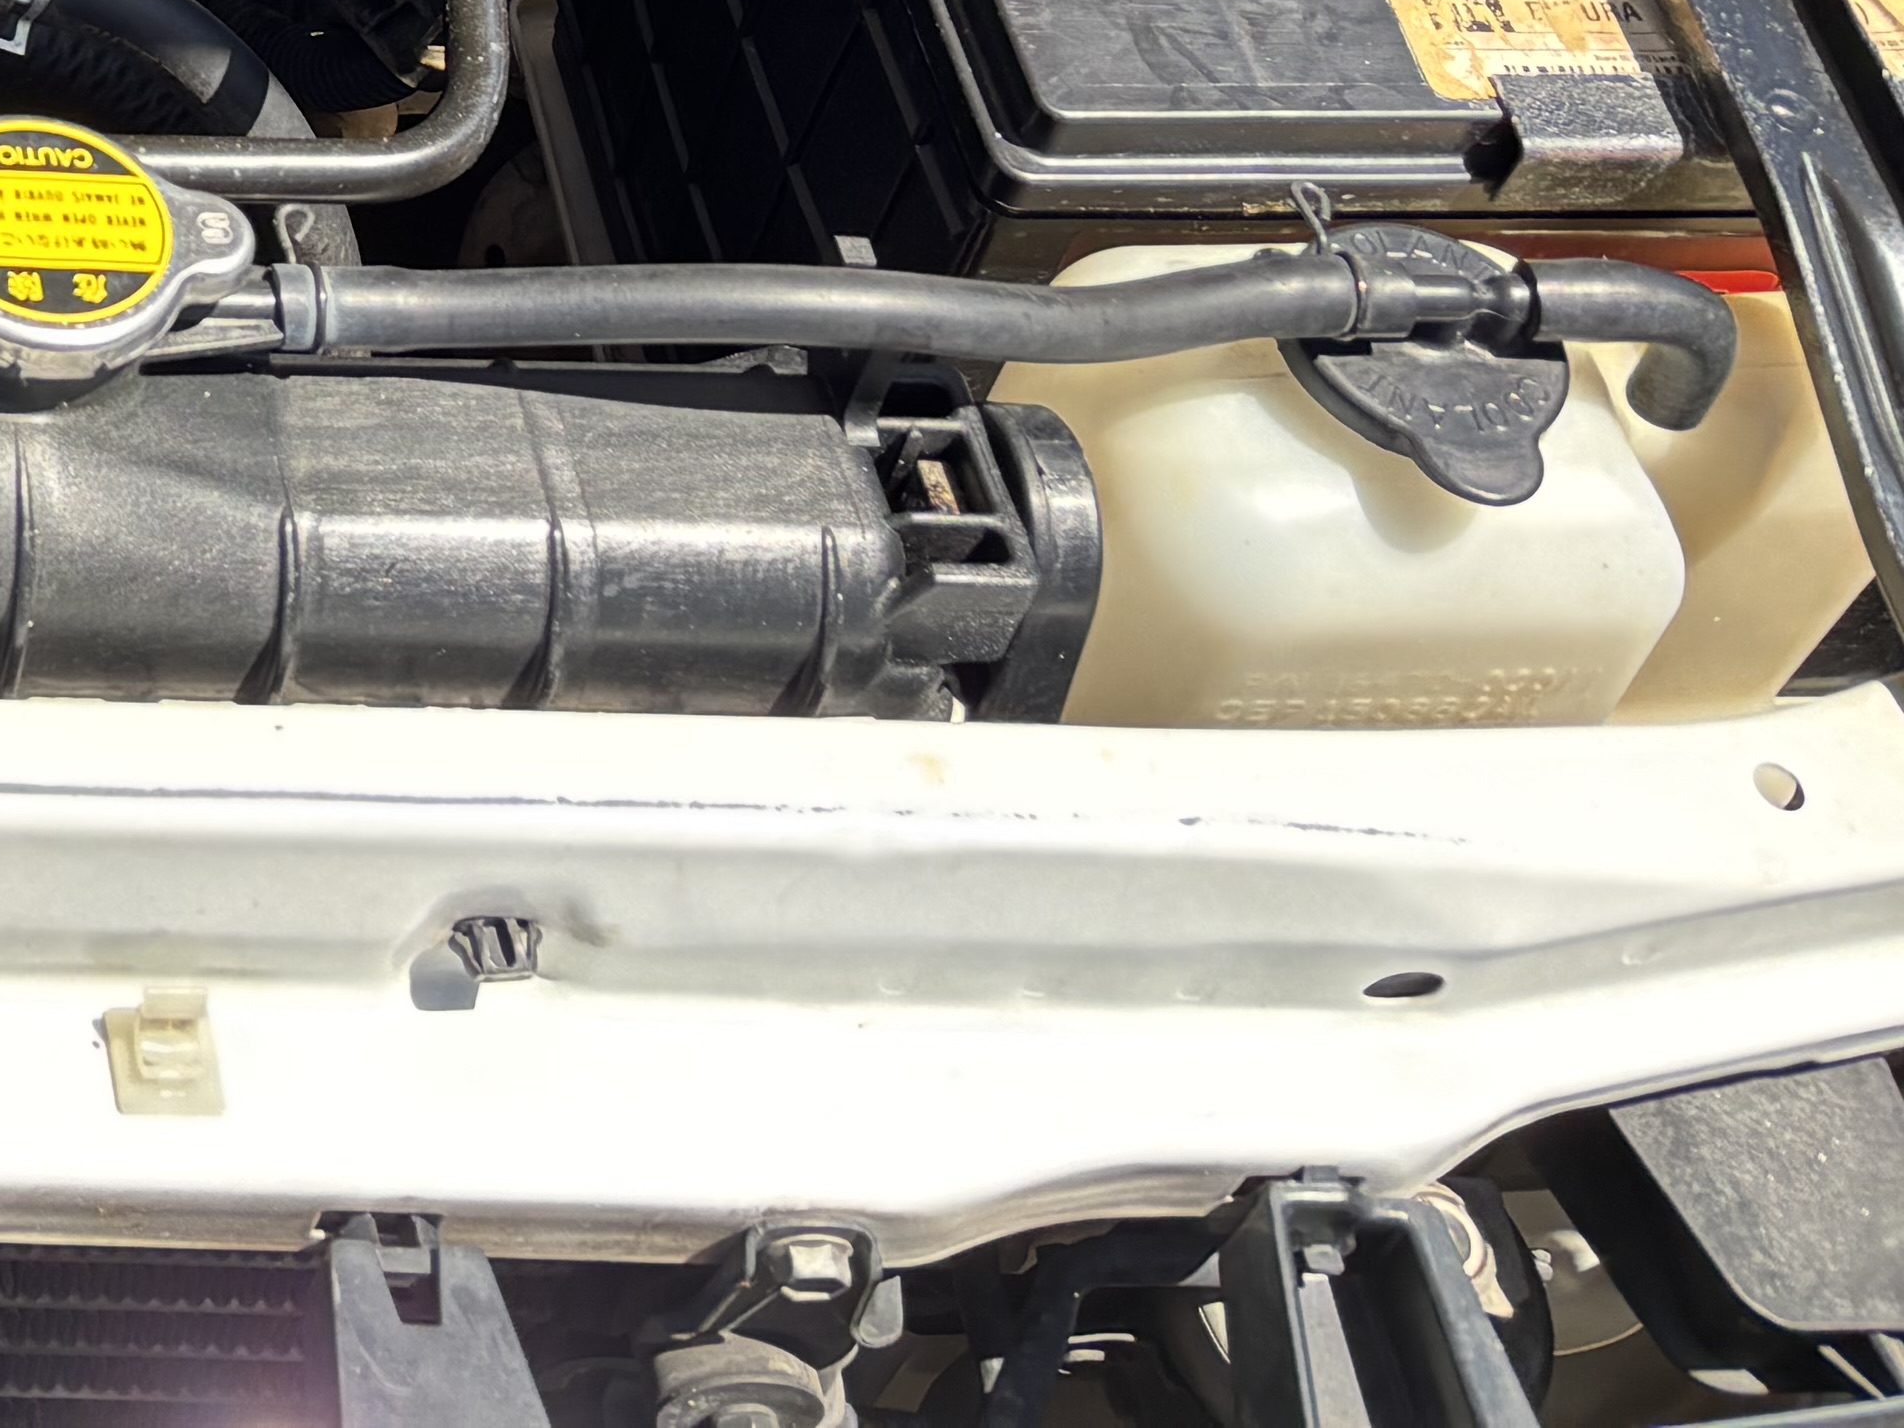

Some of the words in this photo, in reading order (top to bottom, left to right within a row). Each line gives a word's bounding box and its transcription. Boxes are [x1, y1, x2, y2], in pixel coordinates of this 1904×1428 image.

[74, 191, 120, 206] JAMAIS
[14, 210, 53, 225] WHEN
[62, 211, 98, 227] OPEN
[1358, 375, 1551, 434] COOLANT
